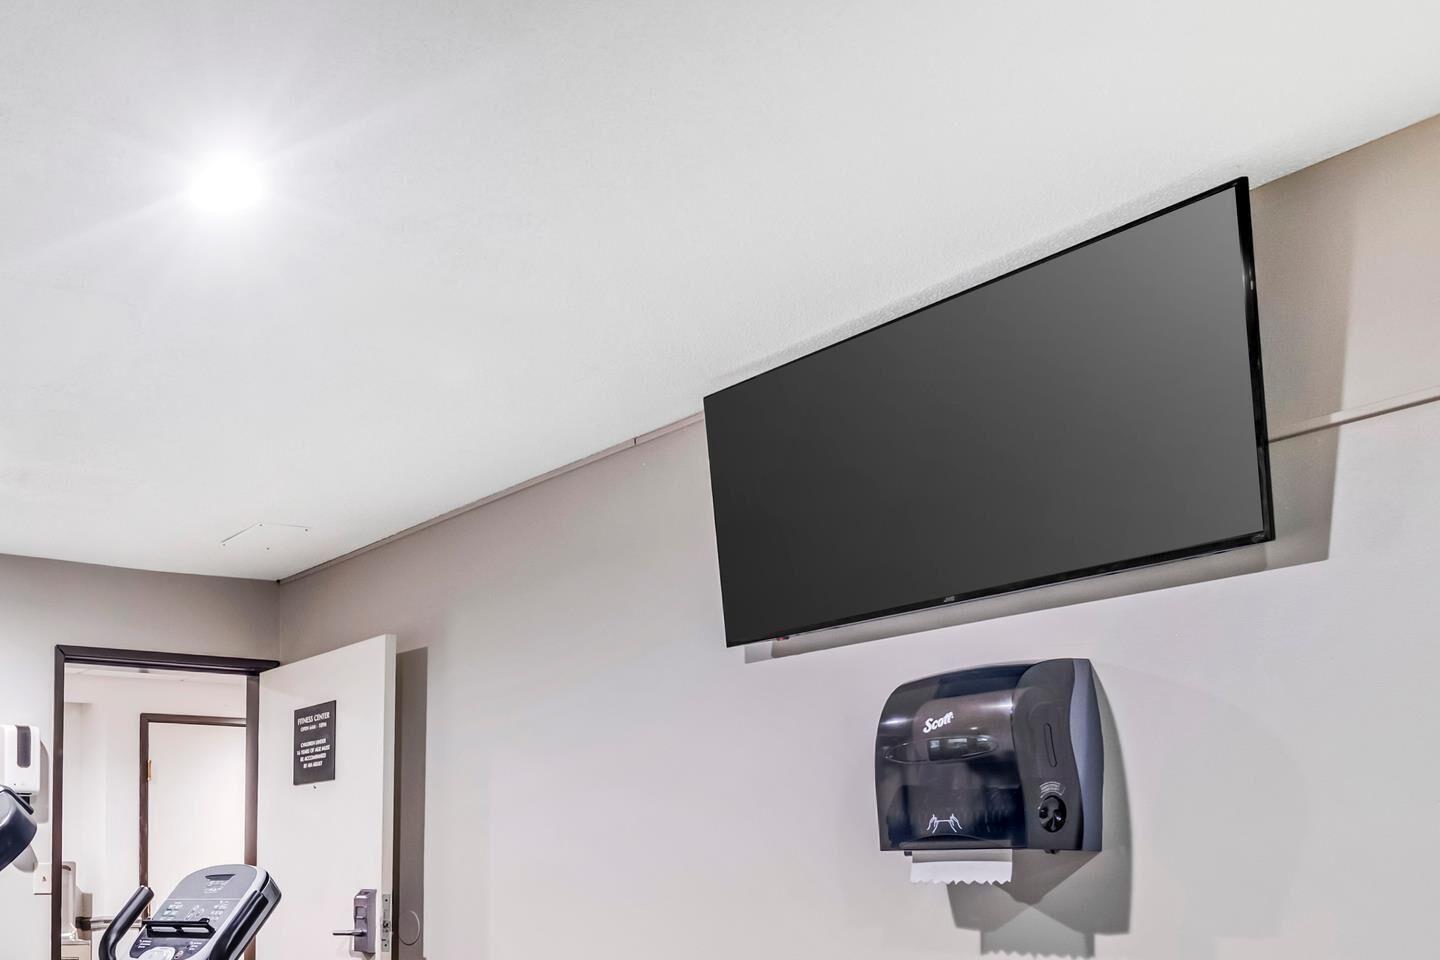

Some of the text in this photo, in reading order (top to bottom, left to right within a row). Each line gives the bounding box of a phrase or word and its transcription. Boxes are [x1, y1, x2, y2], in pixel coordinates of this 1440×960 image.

[298, 712, 330, 725] FITNESS CENTER
[922, 711, 954, 733] Scott
